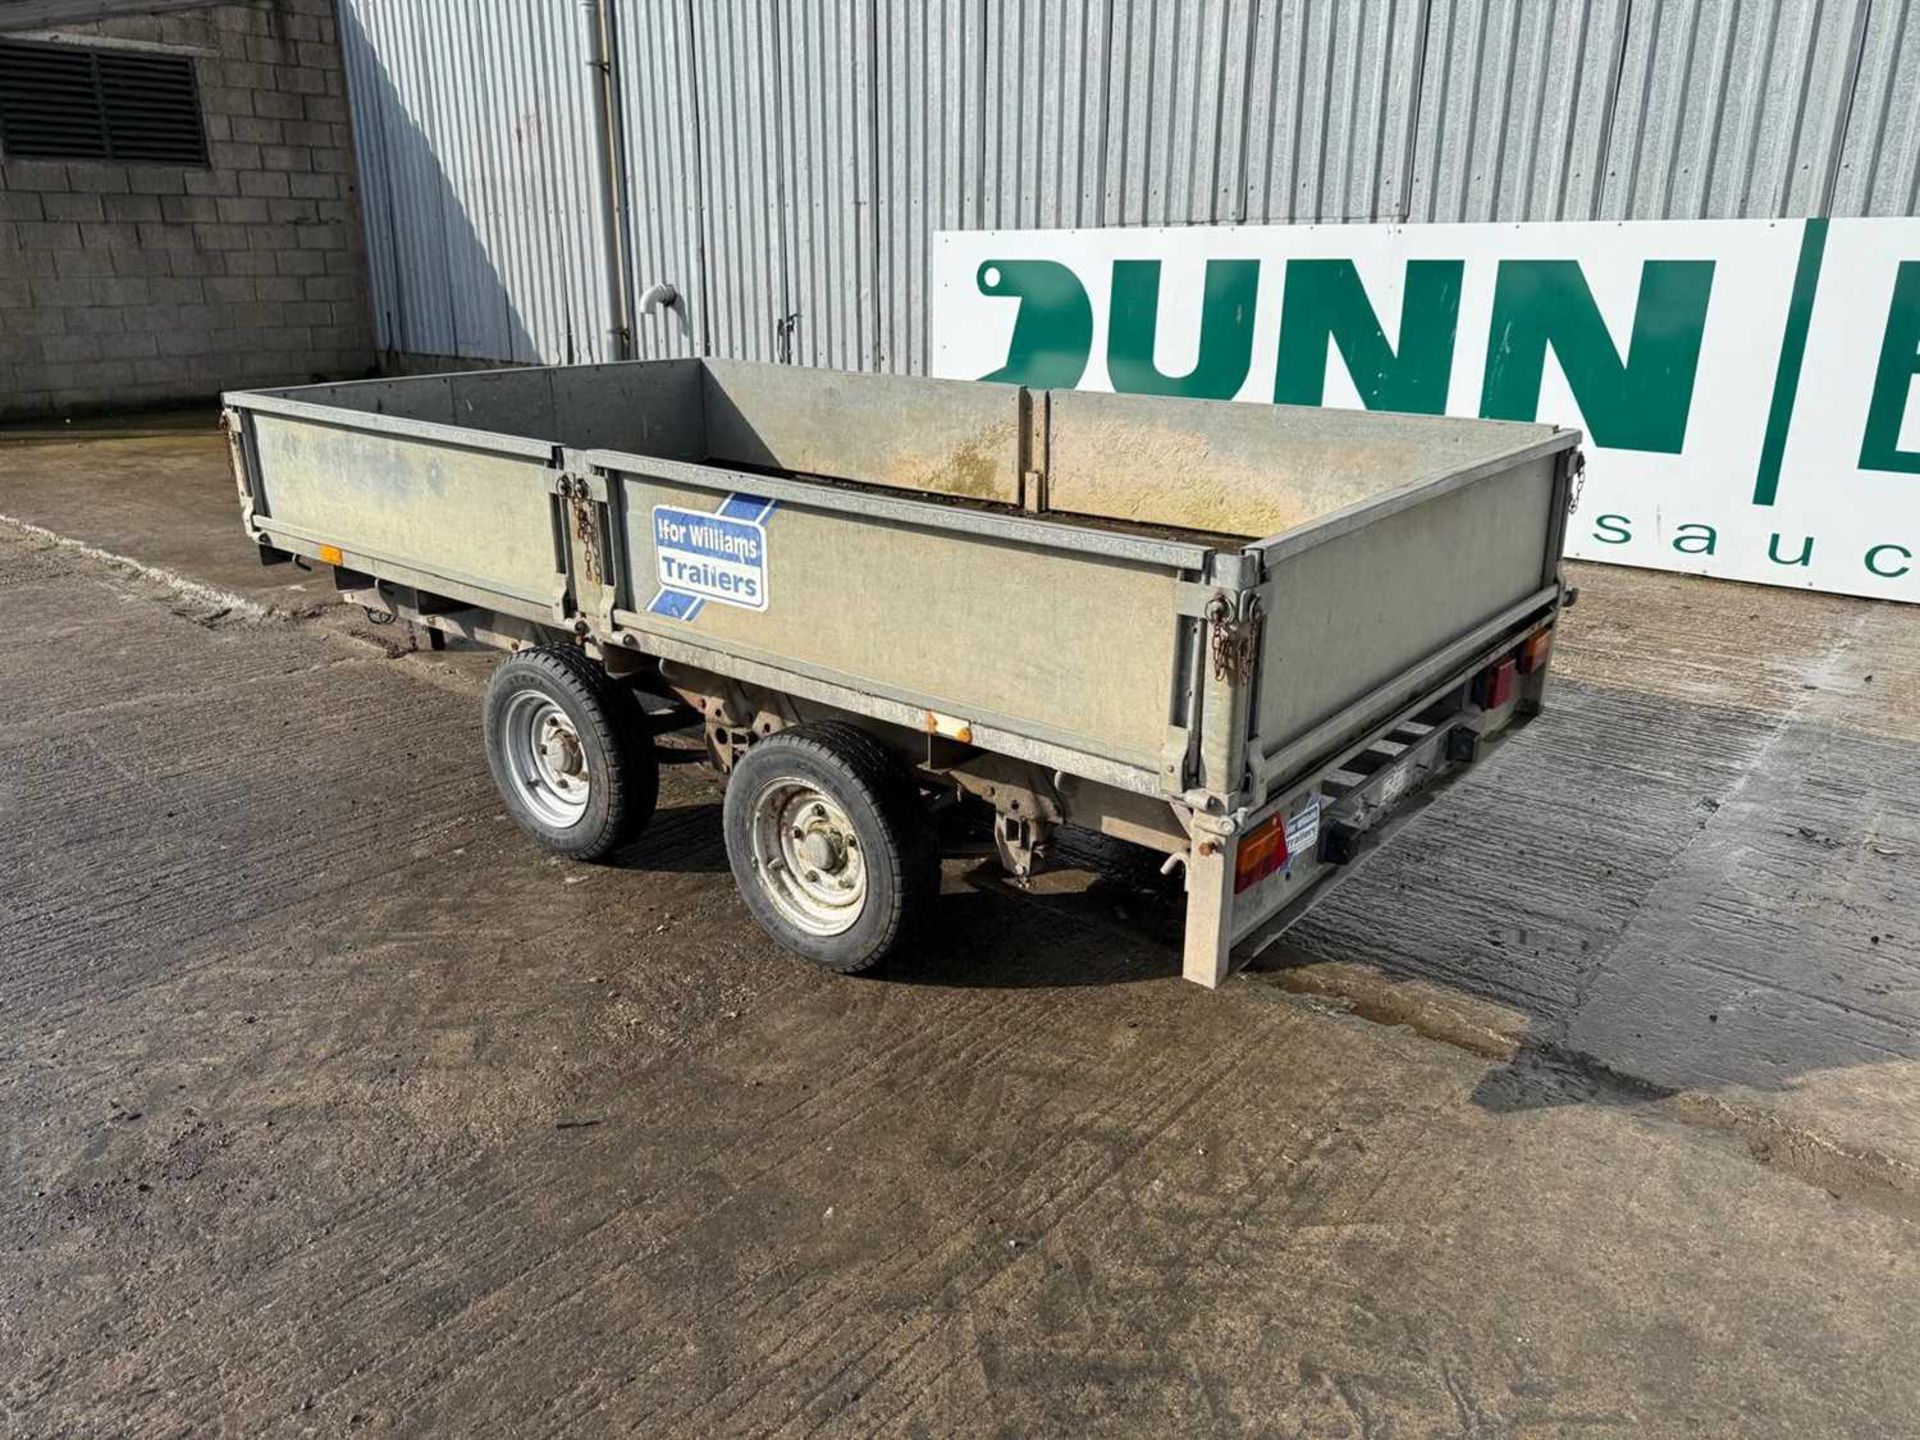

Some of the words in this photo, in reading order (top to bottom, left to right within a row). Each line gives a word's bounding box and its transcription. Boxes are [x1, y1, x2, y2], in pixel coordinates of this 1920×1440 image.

[657, 518, 686, 544] Ifor
[689, 524, 757, 559] Williams
[661, 556, 757, 597] Trailers
